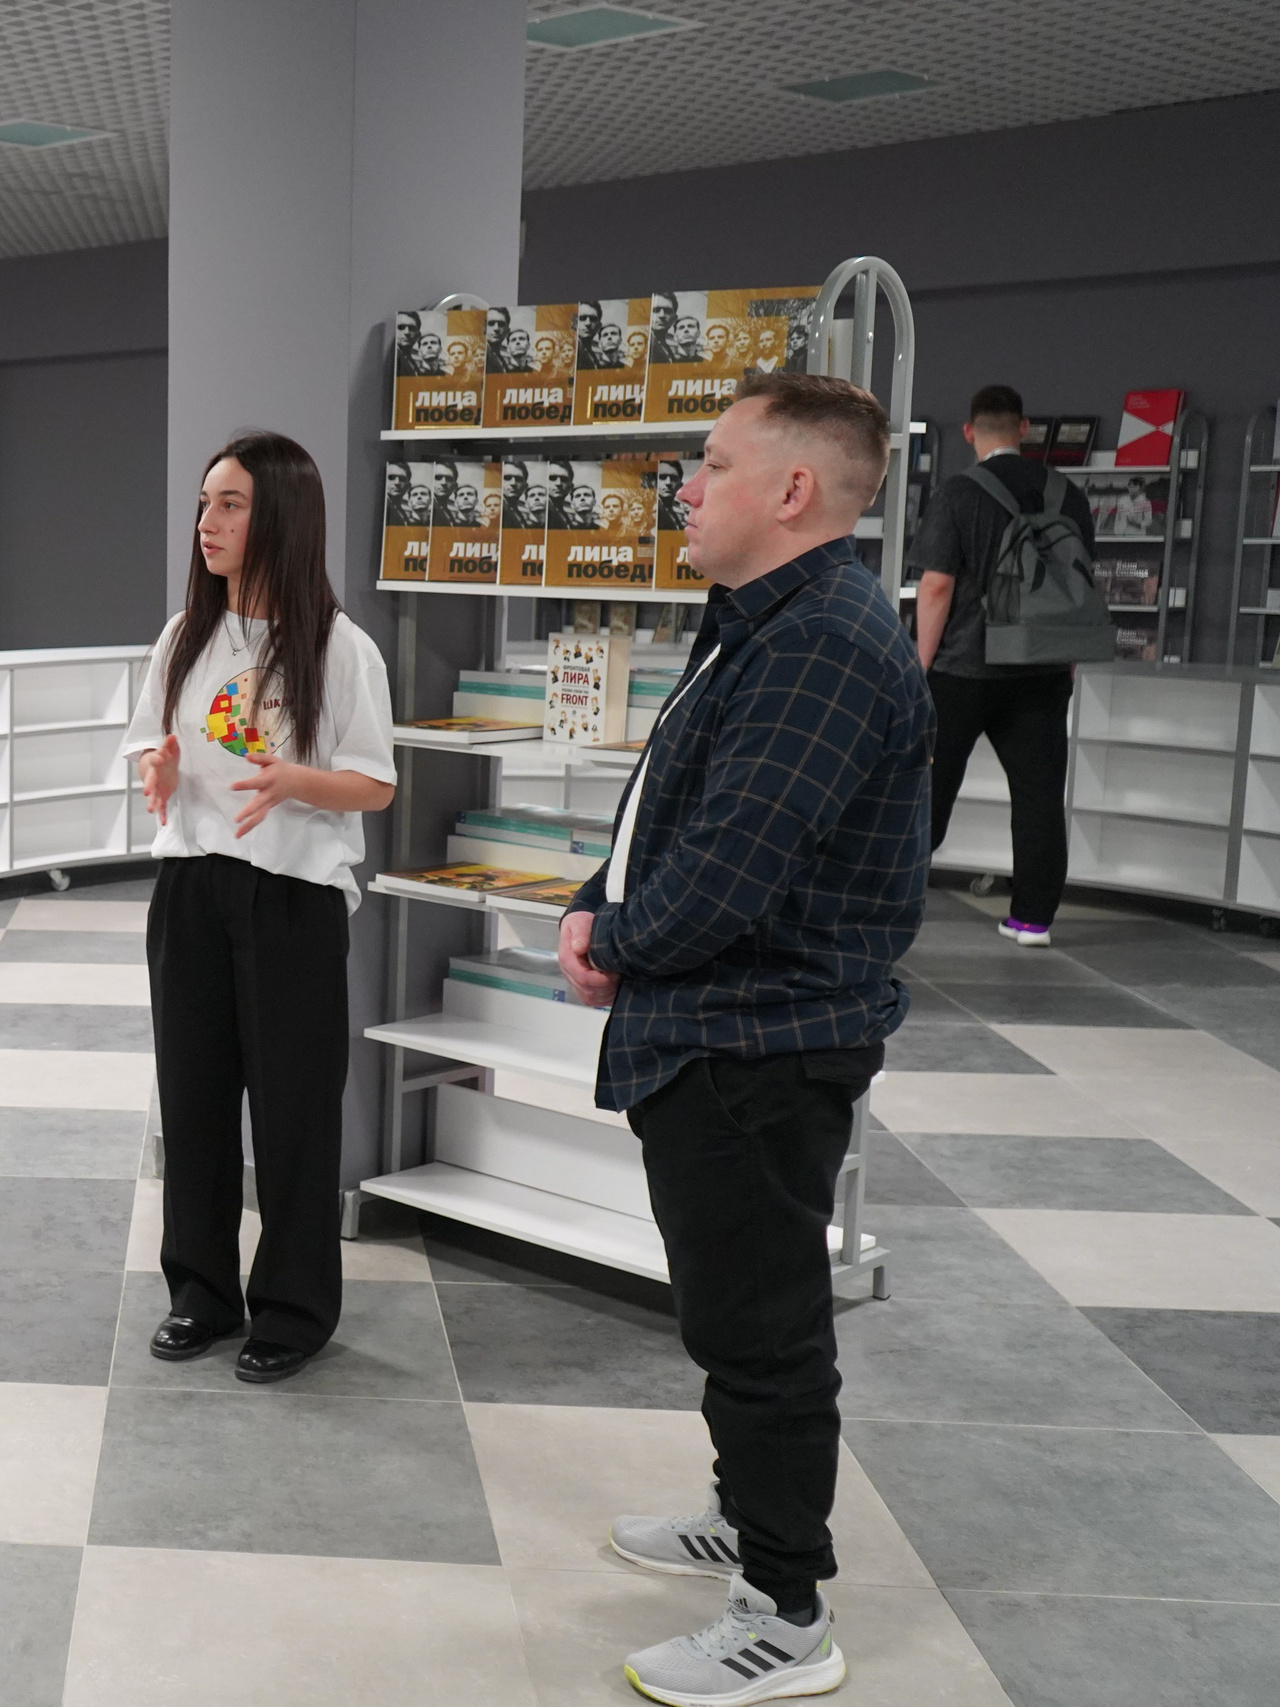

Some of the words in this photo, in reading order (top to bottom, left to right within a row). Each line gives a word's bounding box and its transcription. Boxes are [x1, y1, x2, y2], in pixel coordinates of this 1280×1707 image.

[501, 387, 564, 407] лица
[593, 384, 646, 403] лиц
[667, 378, 738, 399] лица
[415, 390, 478, 409] лица
[449, 542, 499, 561] лиц
[567, 545, 634, 565] лица
[449, 556, 498, 574] поб
[567, 560, 653, 582] побед
[561, 671, 589, 685] ЛИРА
[560, 693, 589, 706] FRONT
